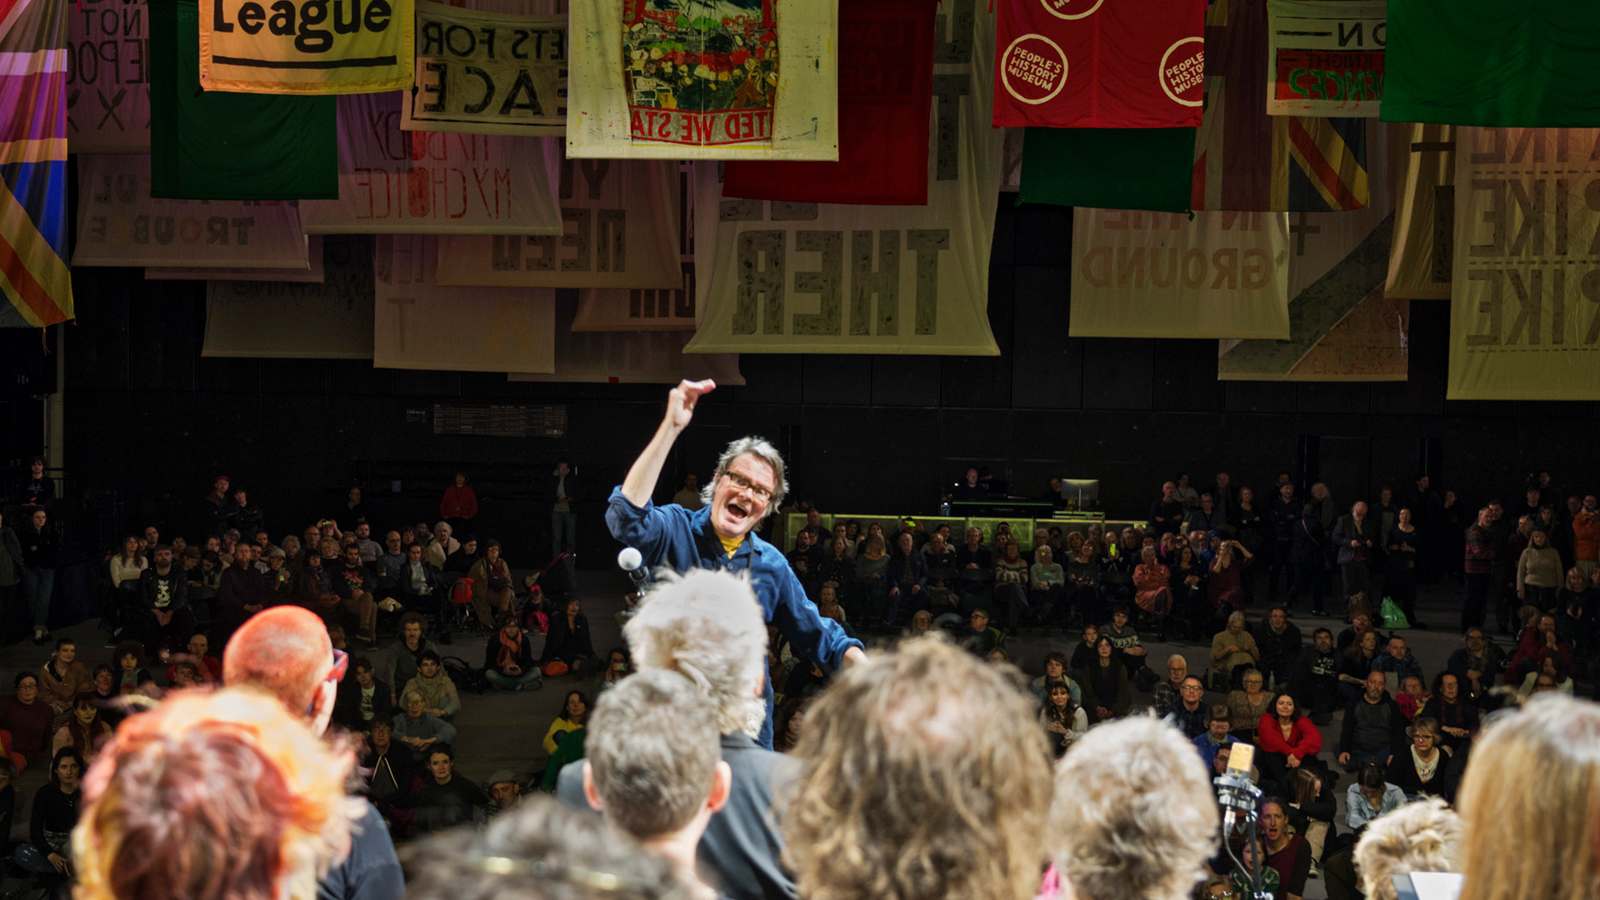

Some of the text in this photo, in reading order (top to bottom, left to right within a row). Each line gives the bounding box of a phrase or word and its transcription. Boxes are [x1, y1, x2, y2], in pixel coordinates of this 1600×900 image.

[213, 0, 392, 53] League
[1010, 56, 1058, 82] HISTORY
[1013, 46, 1063, 74] PEOPLE'S
[1007, 64, 1053, 91] MUSEUM
[1170, 61, 1204, 87] HISTO
[1173, 72, 1204, 95] MUSE
